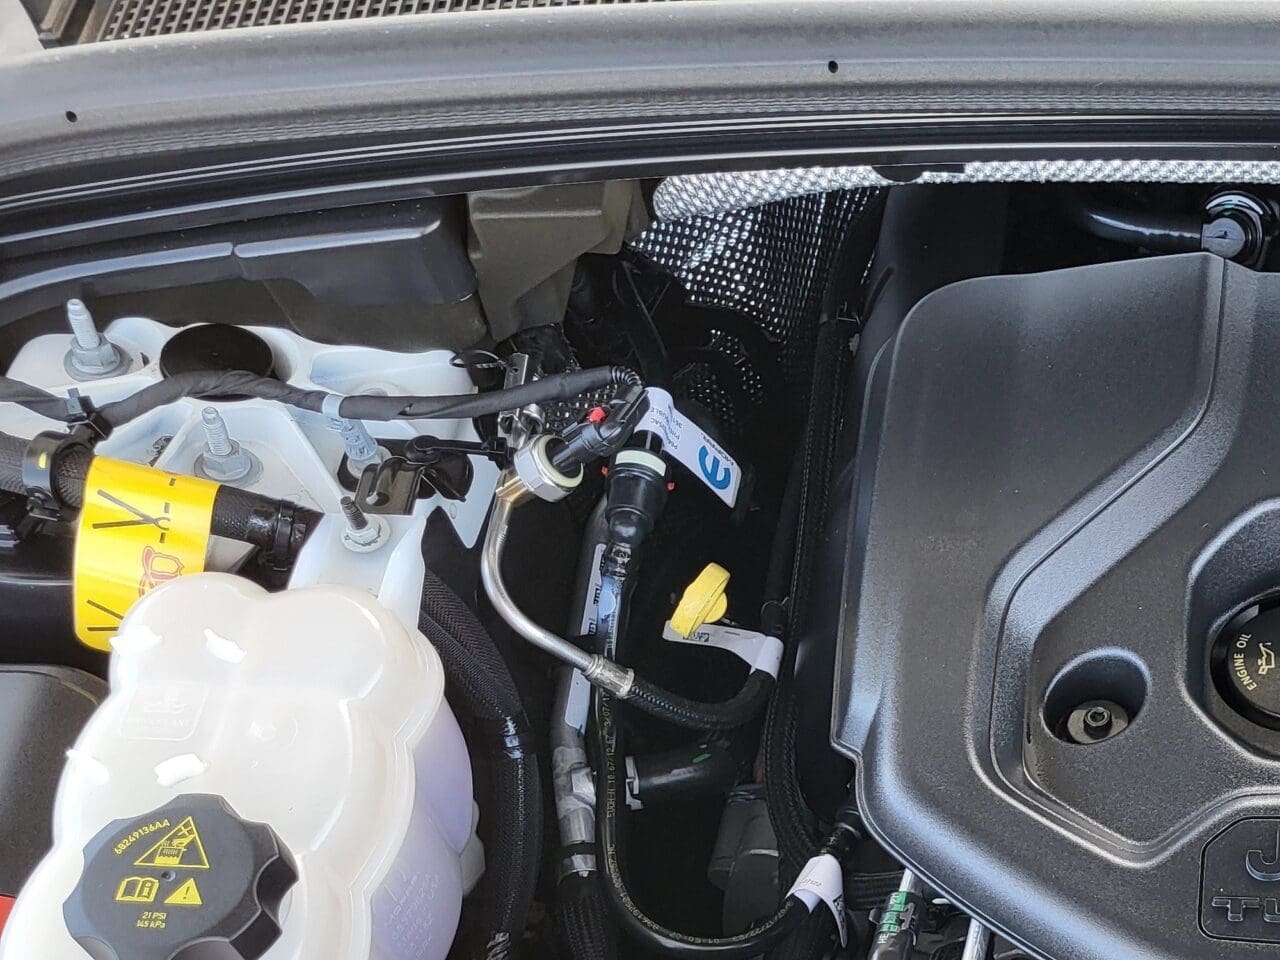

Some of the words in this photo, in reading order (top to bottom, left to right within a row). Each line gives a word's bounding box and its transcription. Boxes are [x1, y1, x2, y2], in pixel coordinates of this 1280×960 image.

[1236, 633, 1252, 649] OIL
[1233, 652, 1258, 691] ENGINE
[113, 818, 172, 856] 68249136AA
[142, 911, 152, 920] 21
[152, 912, 168, 921] PSI
